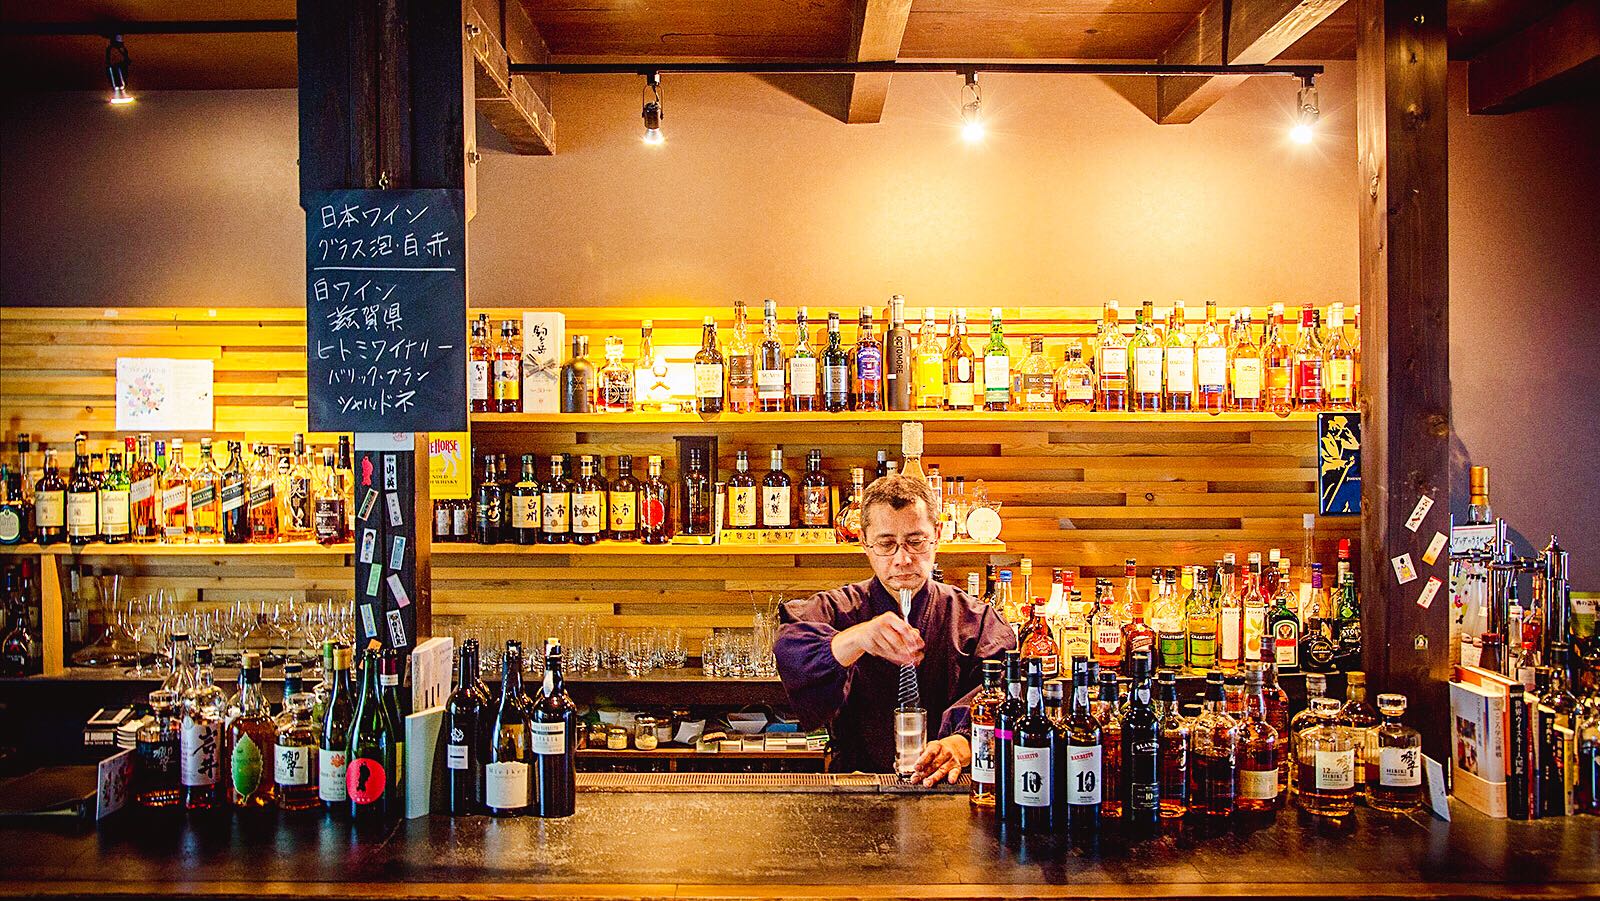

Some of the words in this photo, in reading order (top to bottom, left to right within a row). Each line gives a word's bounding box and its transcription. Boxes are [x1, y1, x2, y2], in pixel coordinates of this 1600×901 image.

[321, 204, 429, 229] 日本ワイン
[313, 277, 397, 302] 白ワイン
[326, 302, 403, 332] 滋賀県
[317, 337, 453, 361] ヒトミワイナリー
[895, 336, 904, 374] OCTOMORE
[337, 388, 417, 416] シャルドネ
[435, 438, 458, 454] HORSE
[526, 499, 538, 522] 白州
[543, 504, 566, 518] 余市
[573, 504, 598, 518] 宮城峡
[193, 725, 220, 780] 岩井
[1400, 750, 1419, 778] 響
[1021, 770, 1044, 794] 10
[1076, 770, 1096, 793] 10
